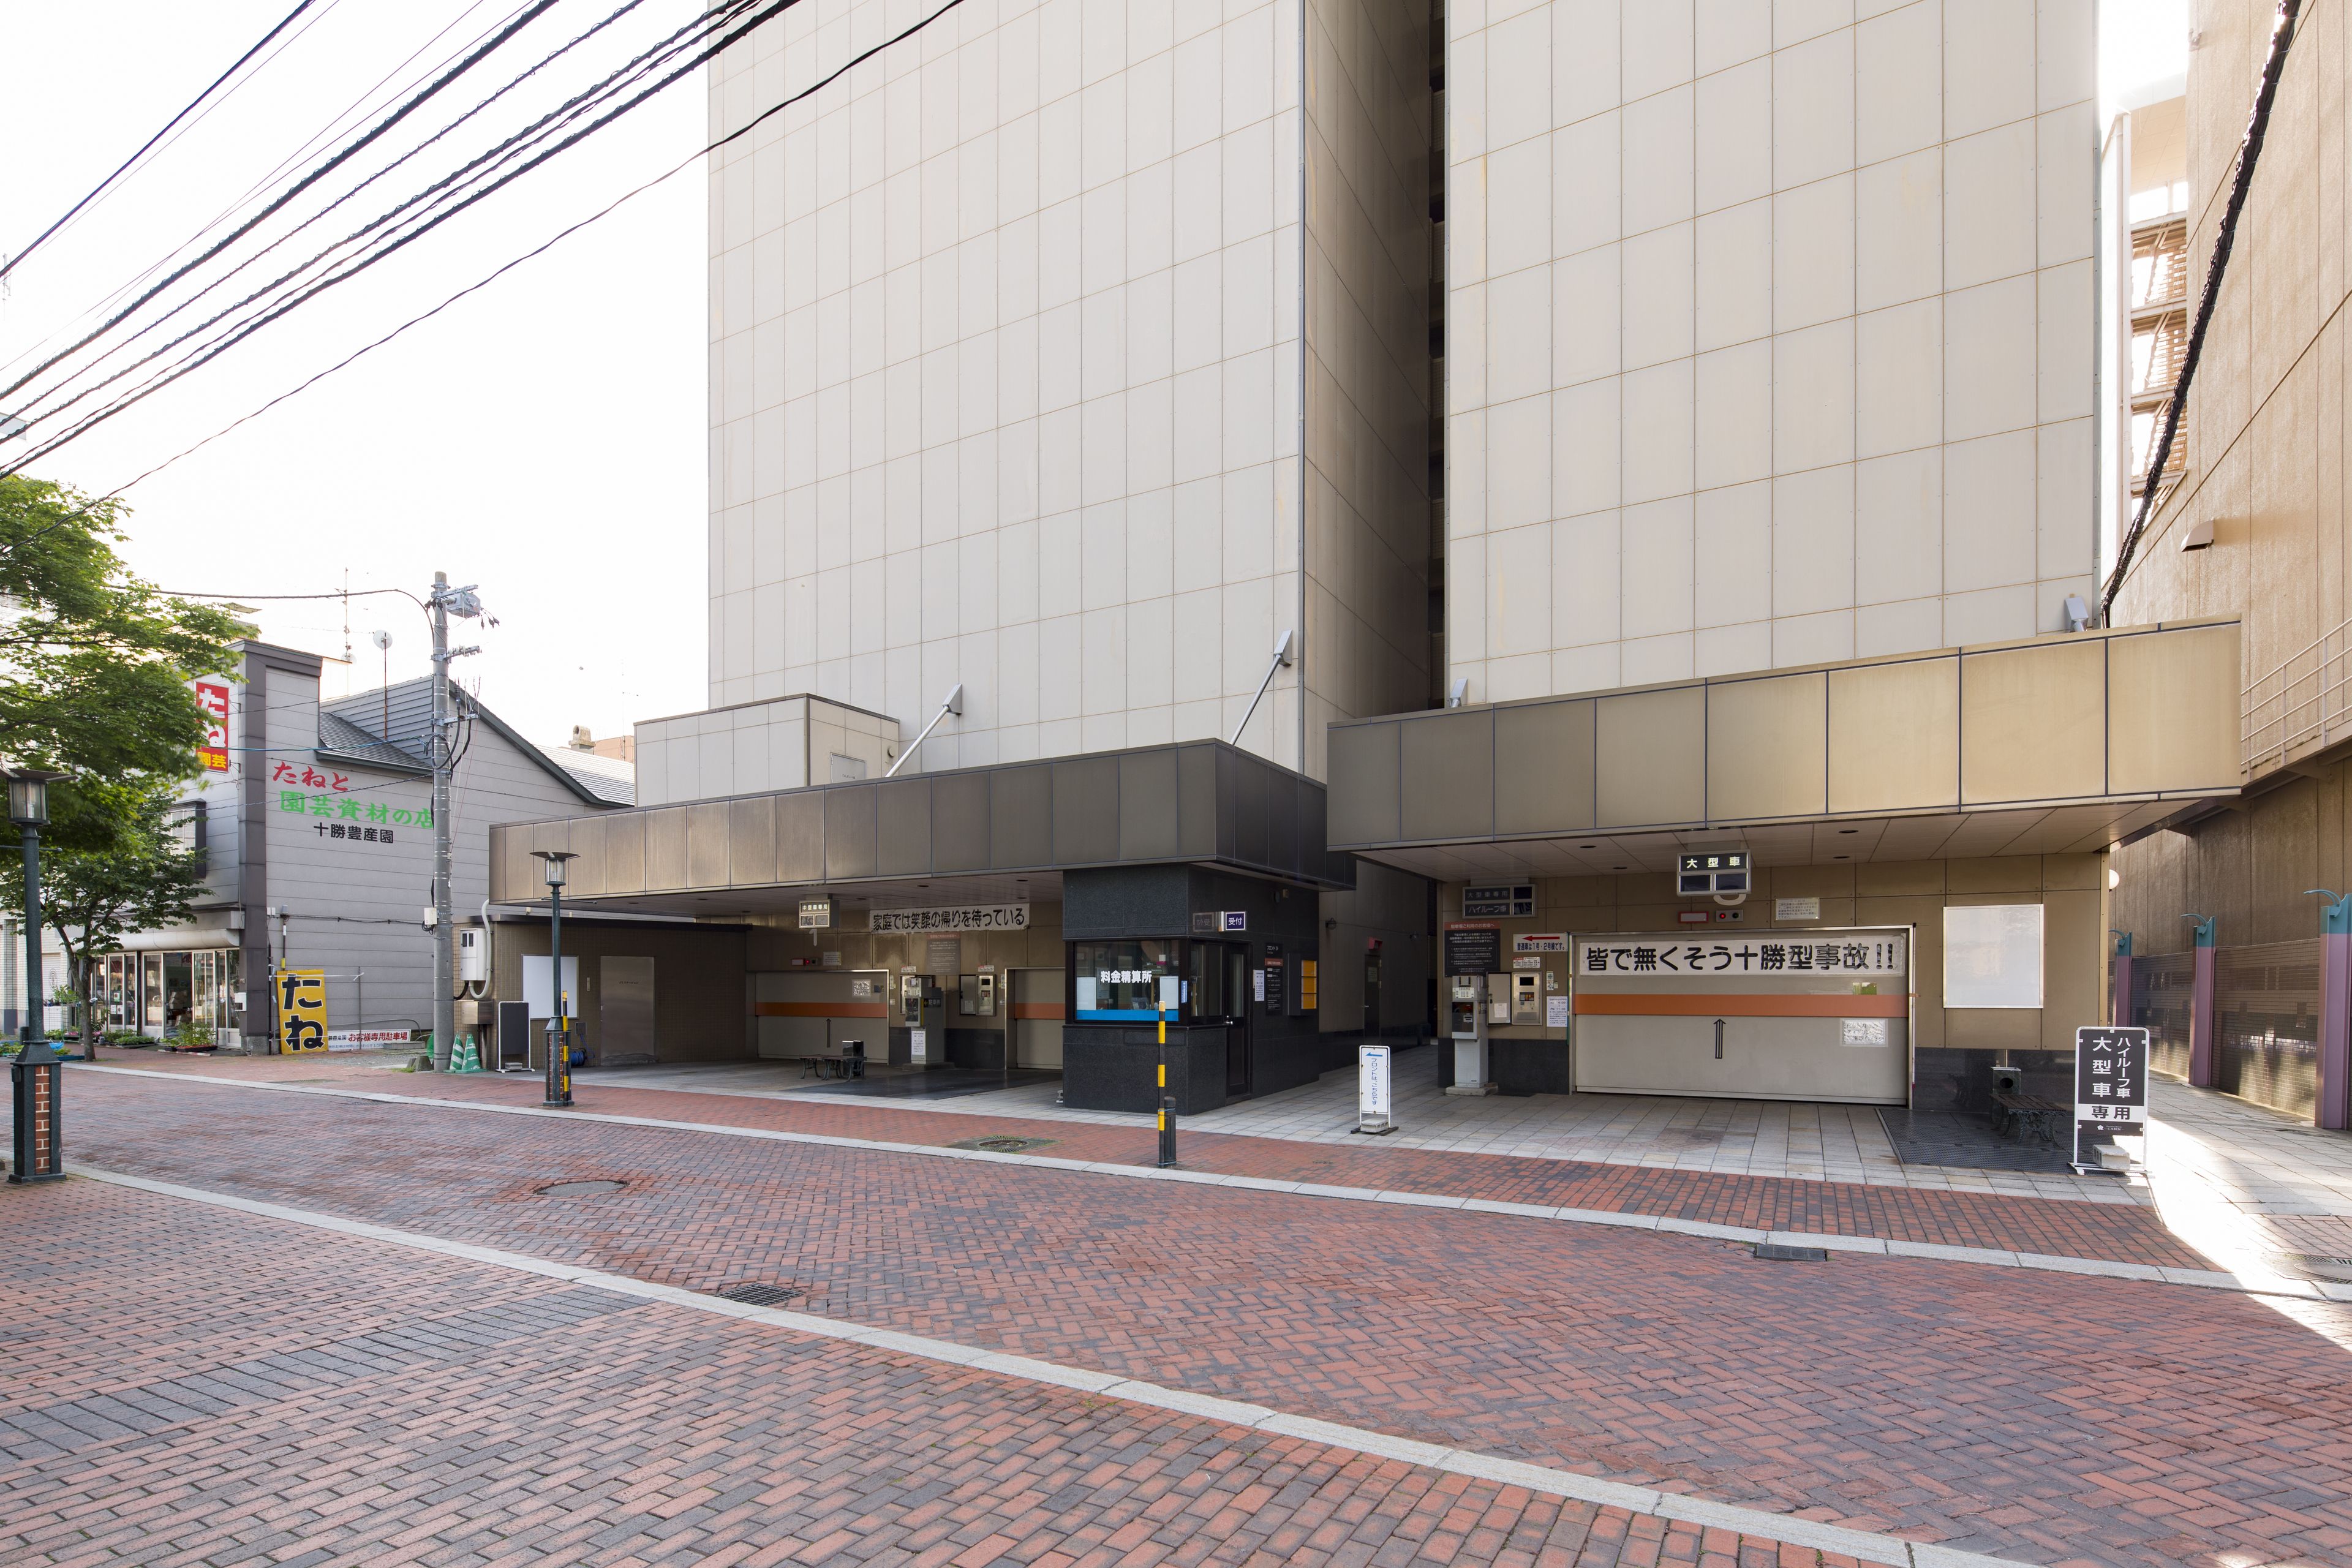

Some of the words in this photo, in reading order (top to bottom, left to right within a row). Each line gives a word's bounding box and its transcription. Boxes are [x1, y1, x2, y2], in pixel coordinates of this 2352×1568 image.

[198, 688, 226, 748] たね
[273, 761, 349, 791] たねと
[280, 791, 434, 829] 園芸資材の店
[314, 822, 393, 843] 十勝豊産園
[1687, 856, 1740, 869] 大型車
[873, 908, 1025, 930] 家庭では笑顔の帰りを待っている
[1101, 970, 1152, 983] 料金精算所
[281, 973, 326, 1052] たね
[348, 1031, 407, 1042] お客様専用駐車場
[2092, 1036, 2112, 1098] 大型車
[2116, 1038, 2131, 1098] ハイルーフ車
[2092, 1106, 2130, 1120] 専用
